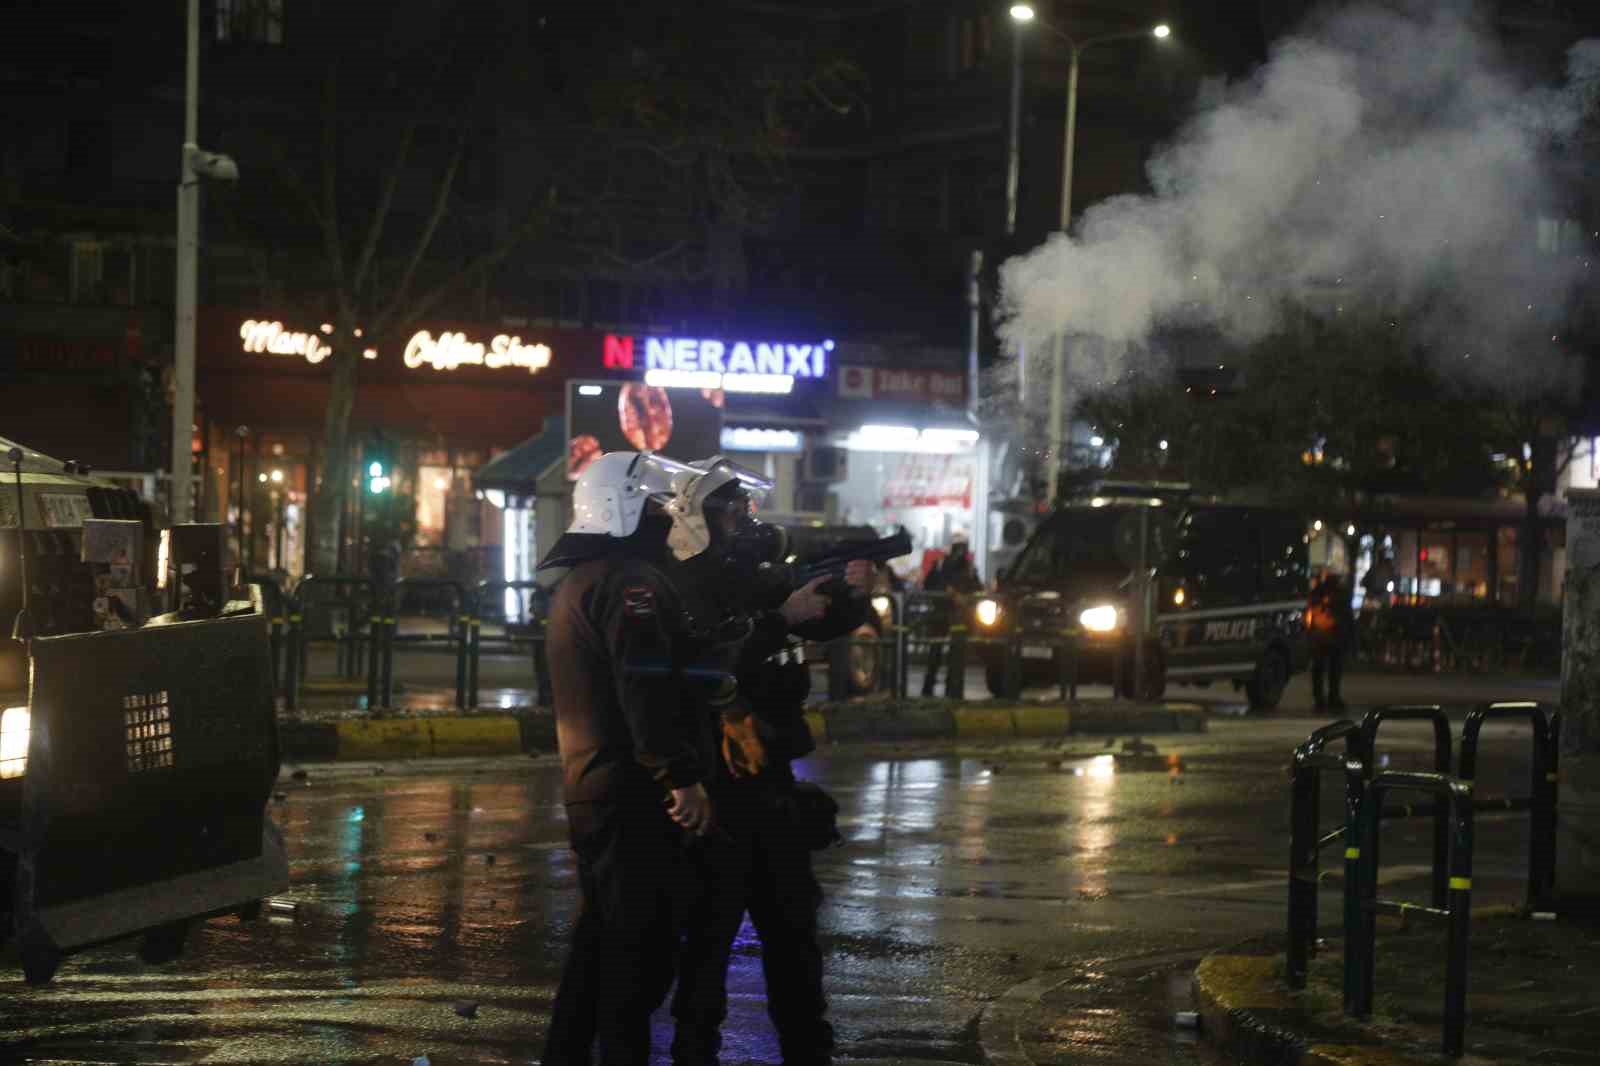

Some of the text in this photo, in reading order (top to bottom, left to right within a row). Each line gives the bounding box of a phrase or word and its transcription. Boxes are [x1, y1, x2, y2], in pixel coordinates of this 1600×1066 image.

[404, 331, 484, 369] Coffee
[485, 335, 550, 372] Shop
[604, 335, 825, 377] N NERANXI
